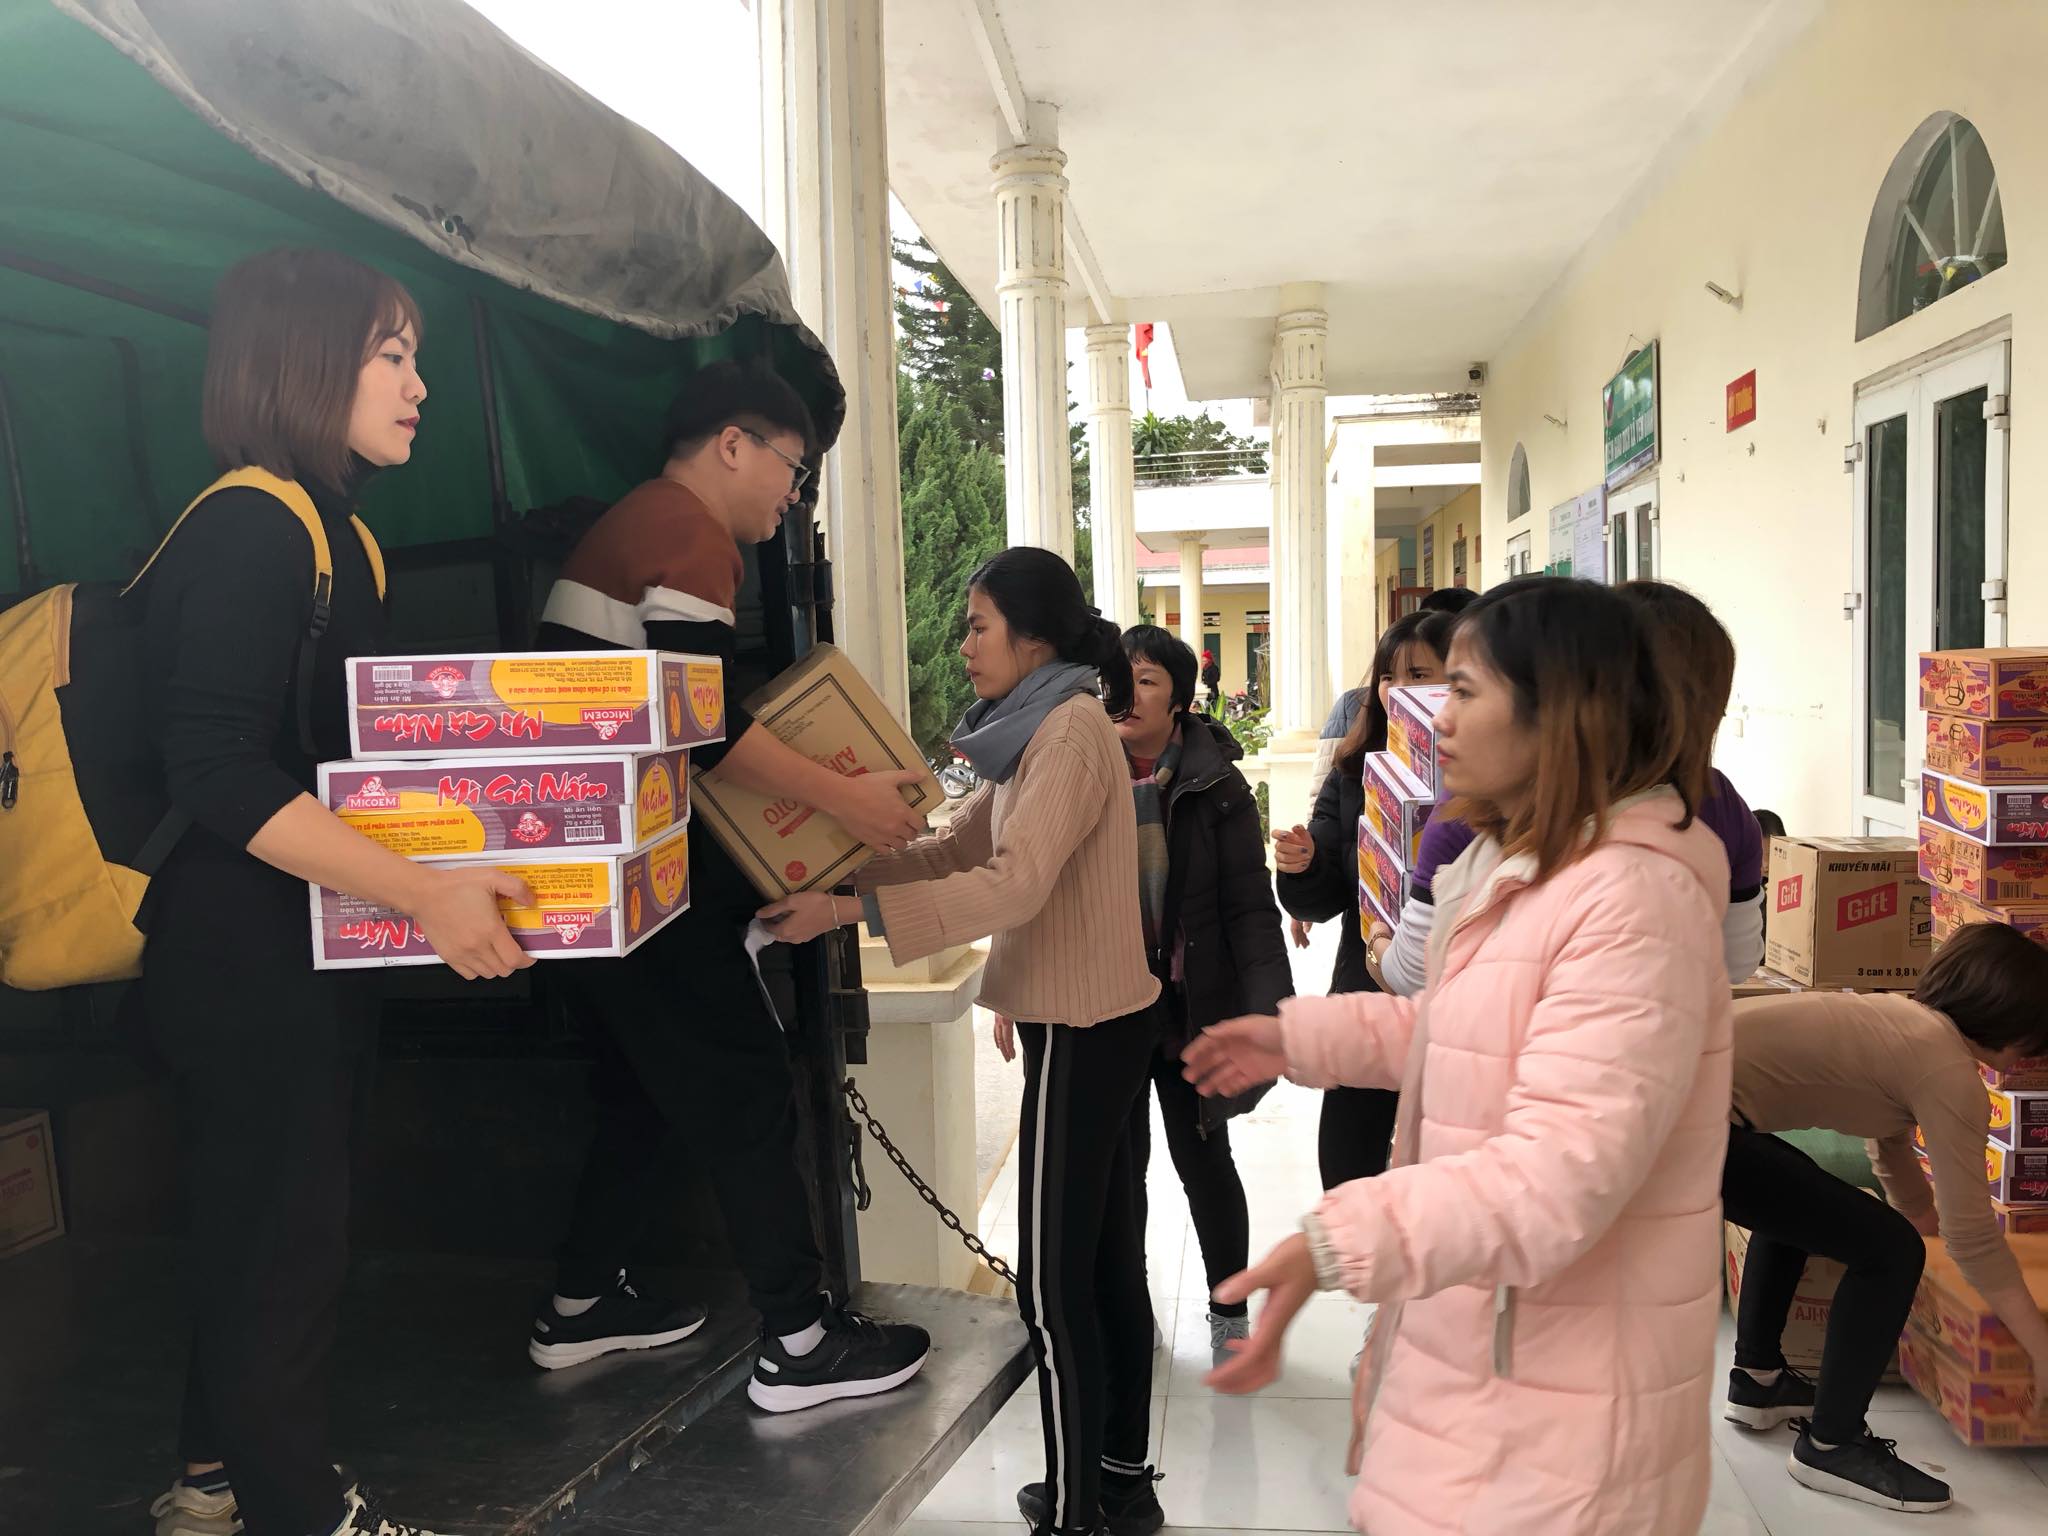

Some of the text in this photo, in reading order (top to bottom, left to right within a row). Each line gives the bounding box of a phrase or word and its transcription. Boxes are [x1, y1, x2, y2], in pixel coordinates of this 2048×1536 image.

[584, 710, 630, 720] MICOEM
[374, 709, 543, 742] Mì Gà Nấm
[437, 772, 608, 808] Mì Gà Nấm
[350, 797, 396, 808] MICOEM
[1828, 860, 1870, 872] KHUYẾN
[1780, 882, 1798, 906] Gift
[1848, 891, 1888, 922] Gift
[546, 913, 590, 923] MICOEM
[1858, 968, 1864, 976] 3
[1896, 968, 1910, 978] 3,8
